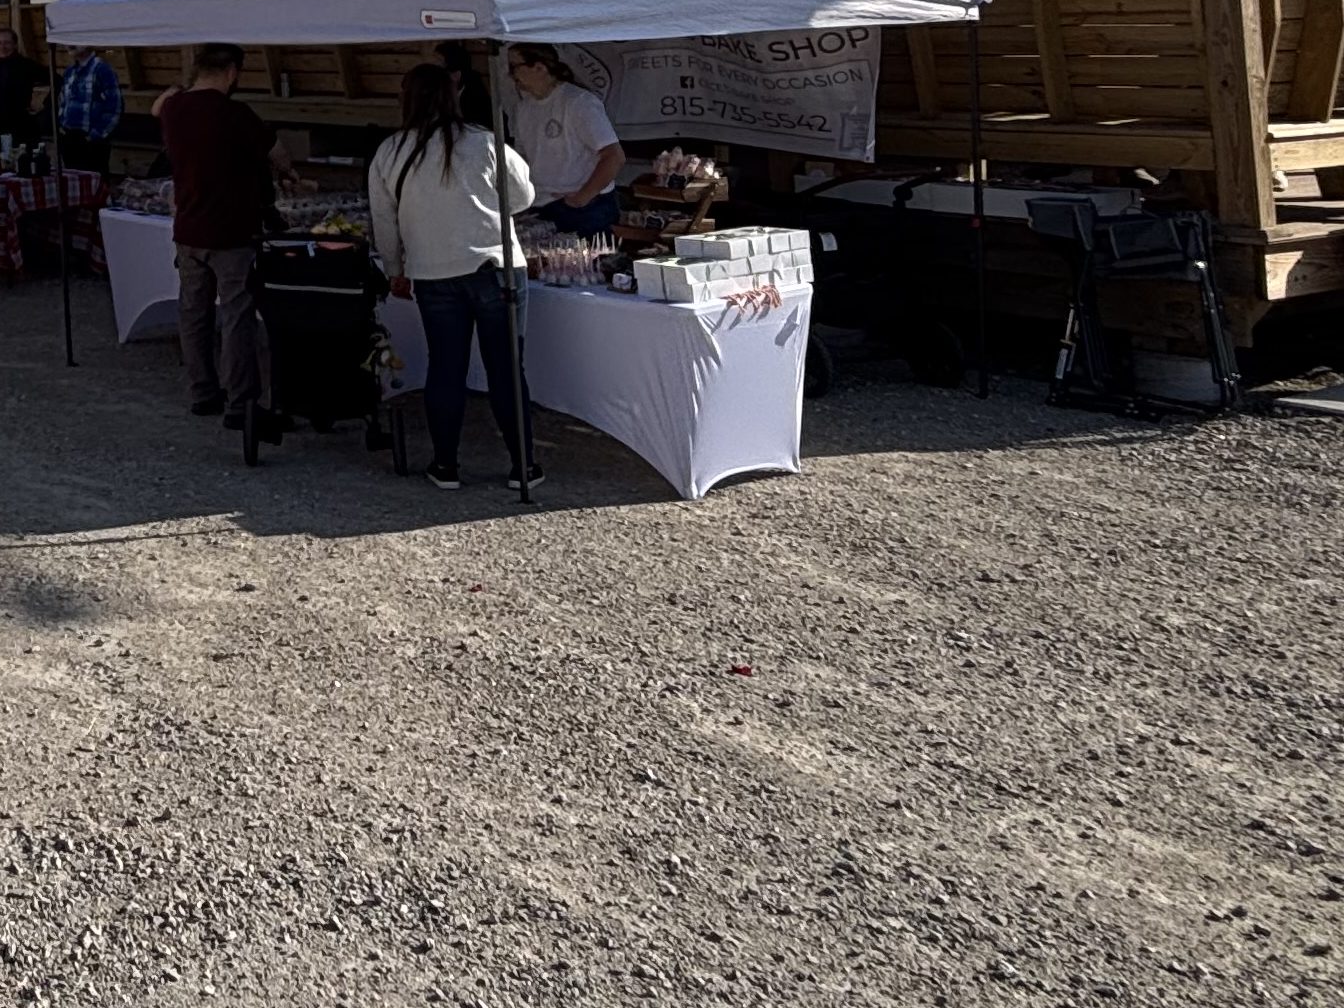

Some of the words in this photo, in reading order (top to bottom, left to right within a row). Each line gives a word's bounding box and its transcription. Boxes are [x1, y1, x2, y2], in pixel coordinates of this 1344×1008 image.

[768, 26, 870, 61] SHOP
[763, 69, 863, 90] OCCASION
[660, 95, 832, 133] 815-735-5542
